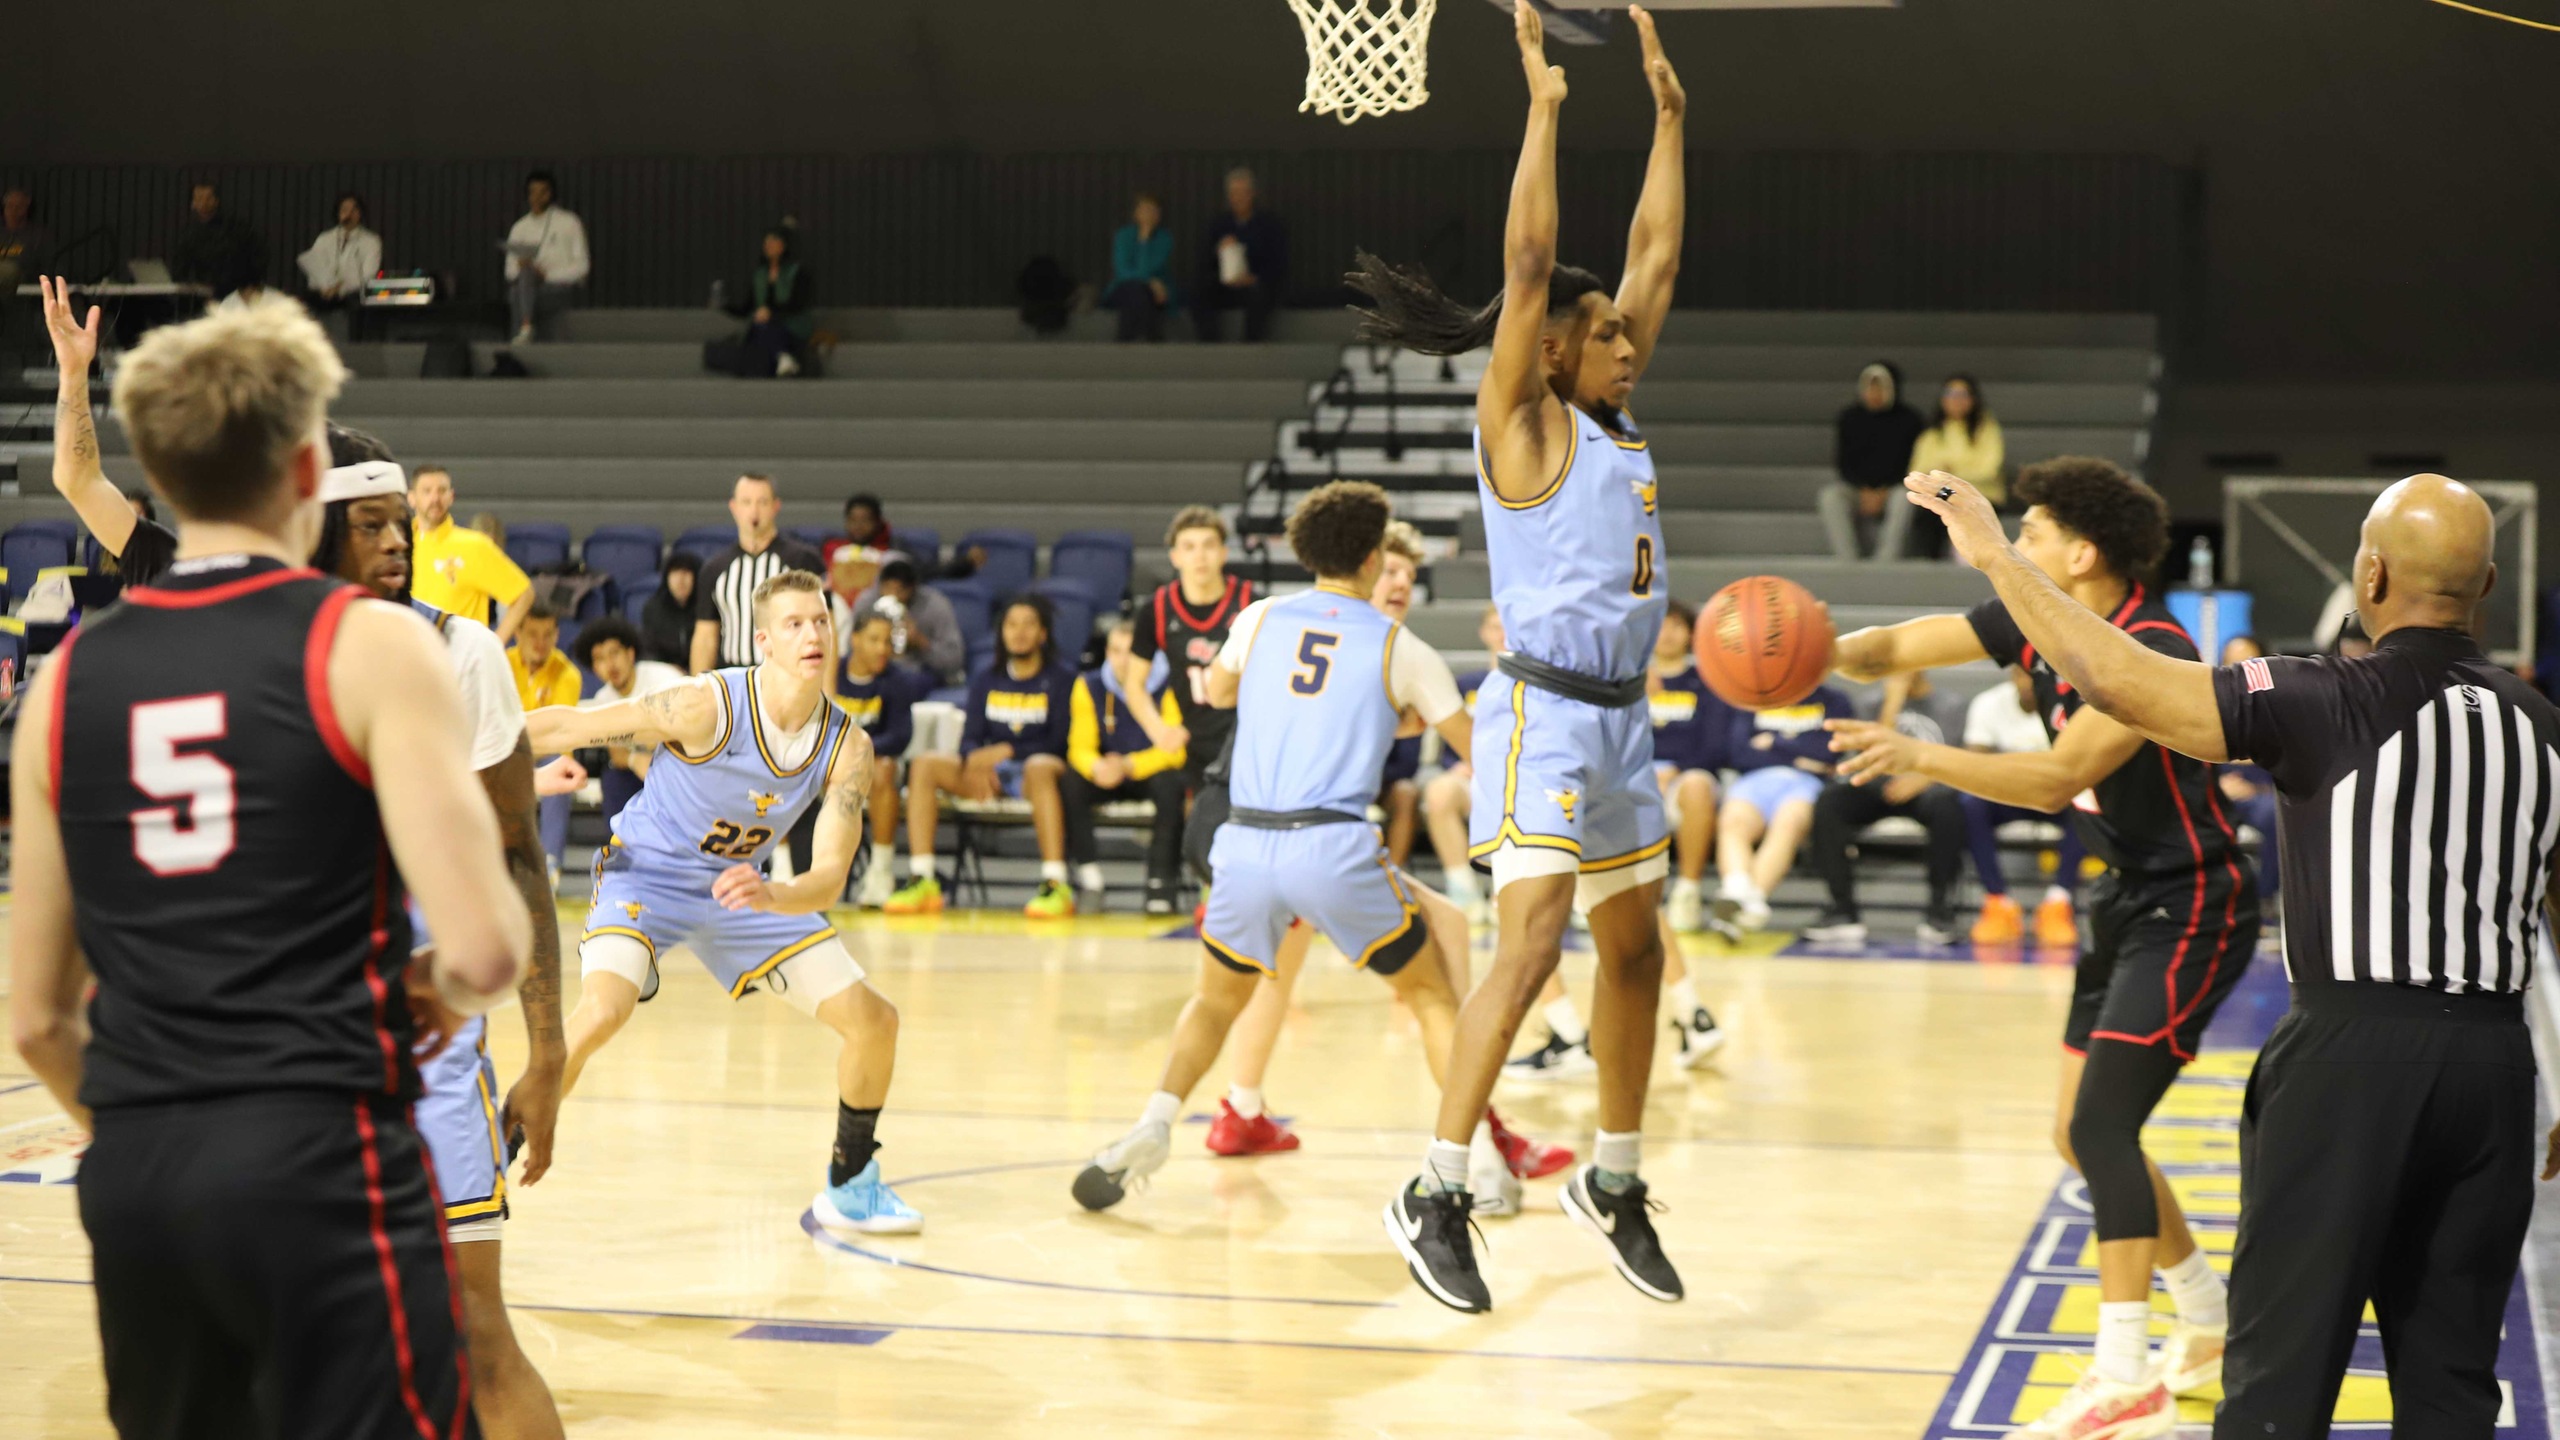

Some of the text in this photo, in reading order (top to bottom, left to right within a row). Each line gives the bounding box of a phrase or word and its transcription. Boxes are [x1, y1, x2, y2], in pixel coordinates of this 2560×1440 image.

[1630, 533, 1654, 598] 0
[1288, 628, 1342, 698] 5
[129, 692, 239, 877] 5
[699, 818, 774, 858] 22
